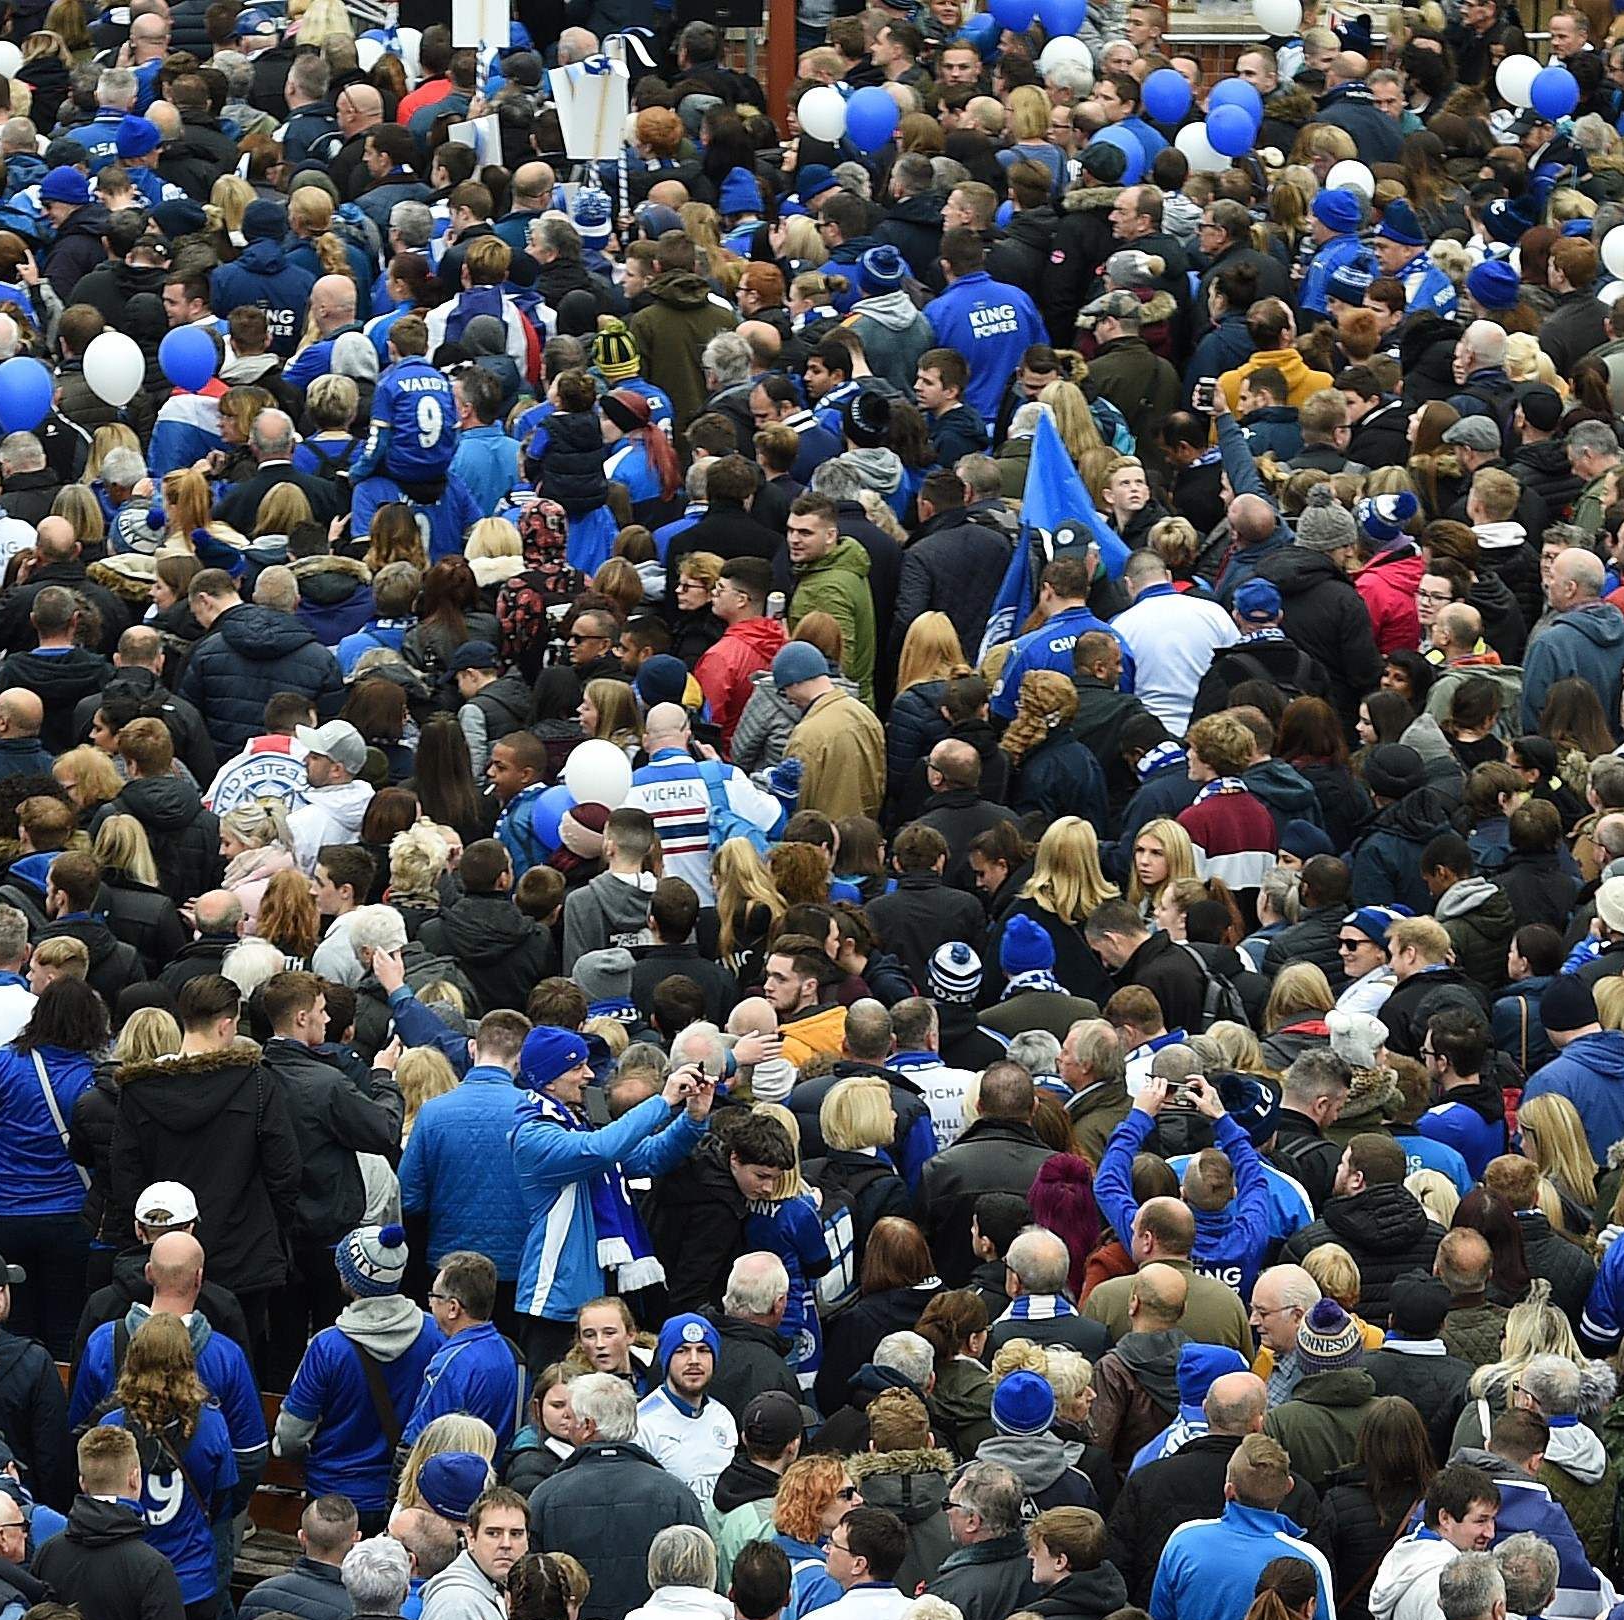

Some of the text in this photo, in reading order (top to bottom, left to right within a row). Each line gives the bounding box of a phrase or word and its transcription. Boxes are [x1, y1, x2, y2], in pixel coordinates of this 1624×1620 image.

[969, 304, 1016, 326] KING
[417, 395, 443, 448] 9
[642, 784, 694, 804] VICHAI
[147, 1467, 184, 1527] 9
